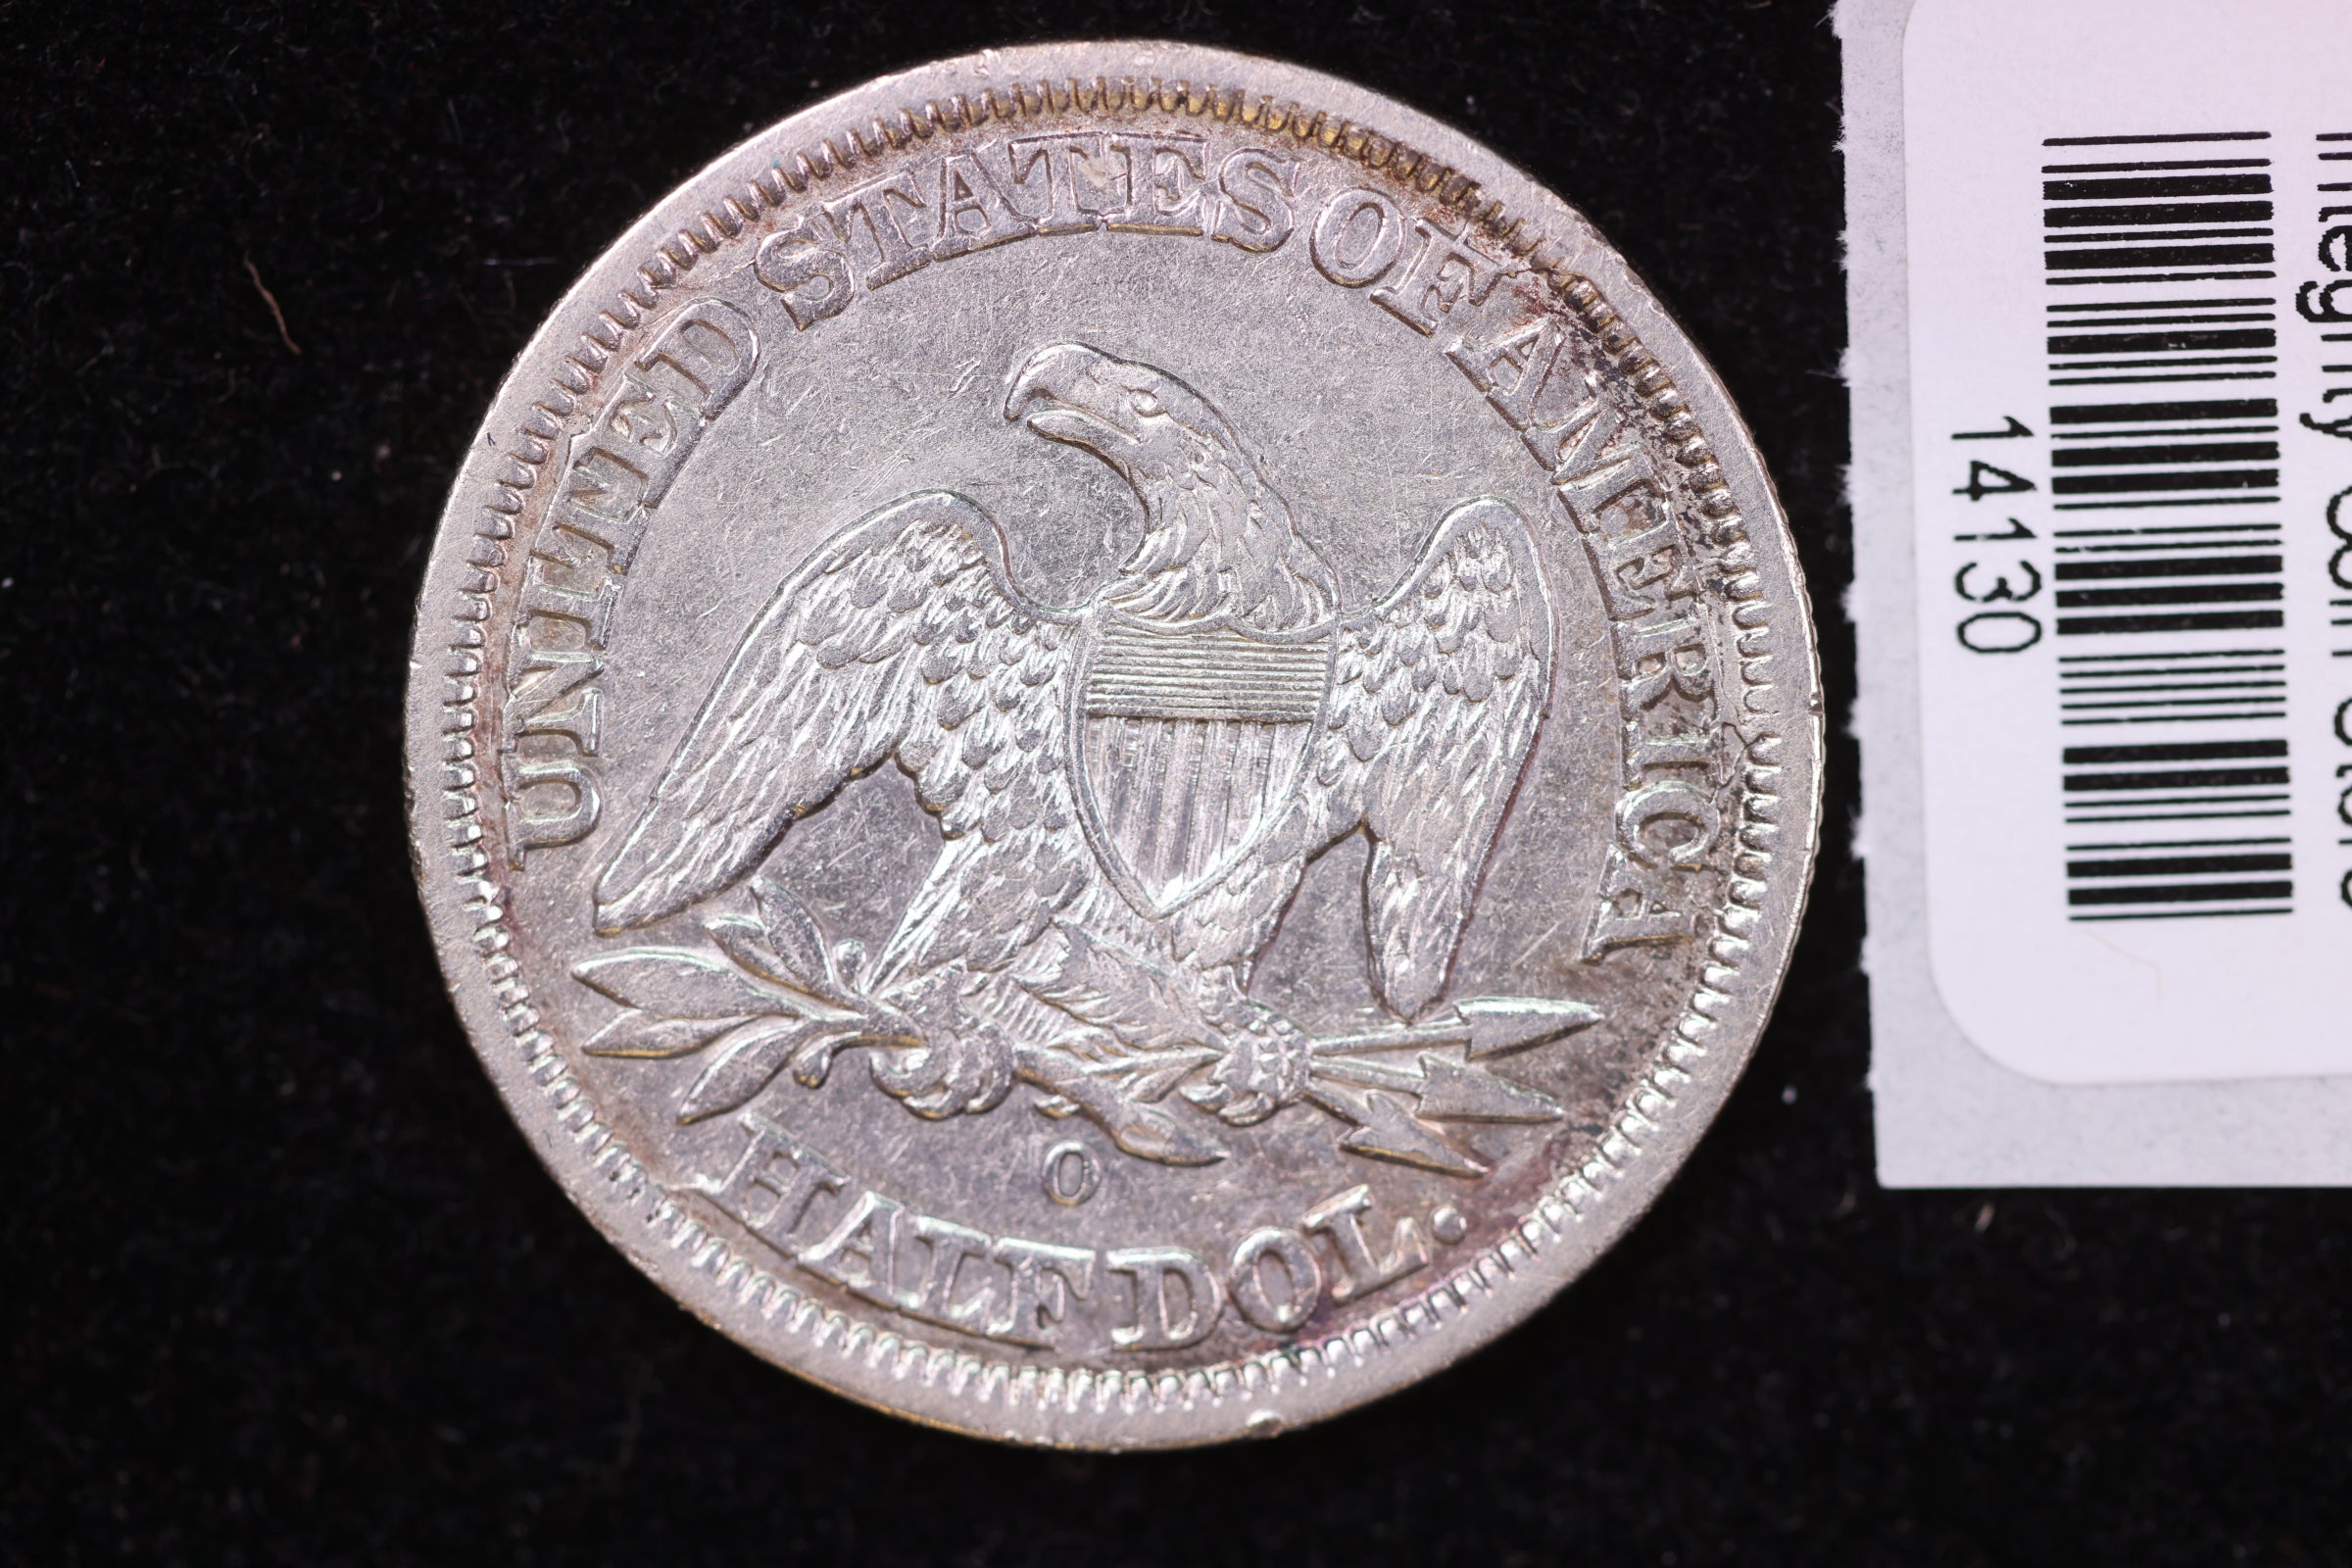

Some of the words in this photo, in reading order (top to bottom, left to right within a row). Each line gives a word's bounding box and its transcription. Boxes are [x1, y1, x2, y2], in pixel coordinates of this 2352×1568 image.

[502, 297, 762, 870] UNITED
[754, 131, 1300, 331] STATES
[1310, 187, 1521, 337] OF
[1443, 316, 1723, 964] AMERICA
[1951, 416, 2042, 655] 14130
[690, 1111, 1097, 1349] HALF
[1109, 1183, 1472, 1352] DOL.
